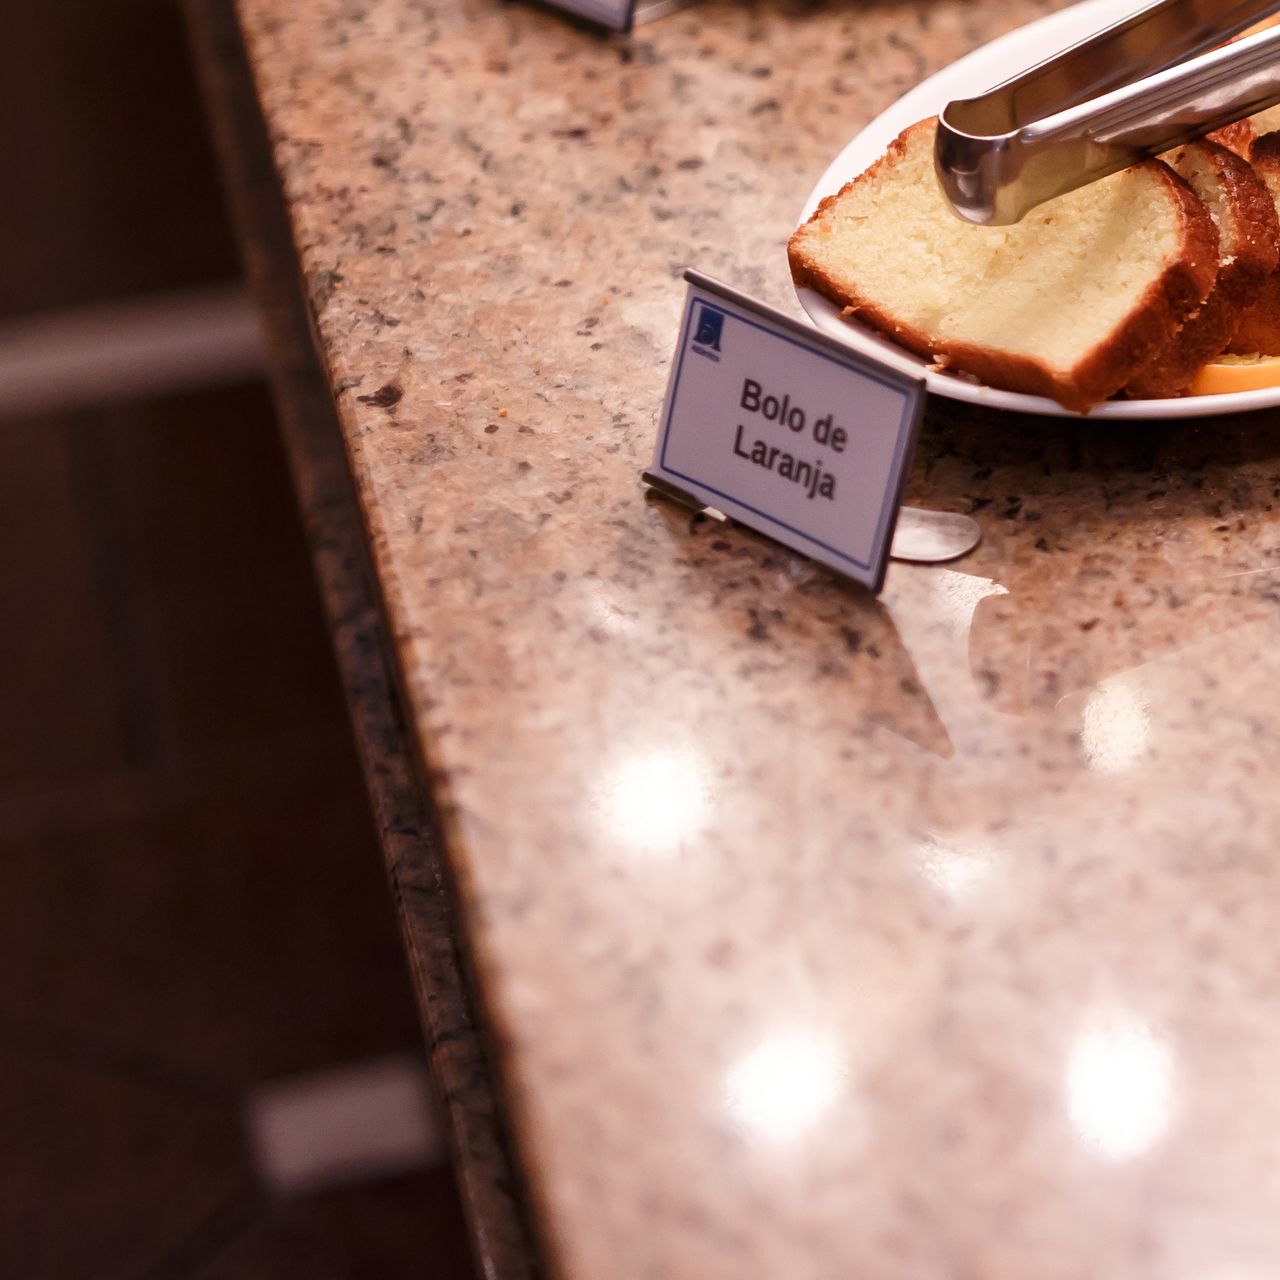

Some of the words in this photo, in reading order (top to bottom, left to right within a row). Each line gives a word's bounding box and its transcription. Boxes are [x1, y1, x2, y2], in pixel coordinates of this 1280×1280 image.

[739, 378, 806, 433] Bolo
[812, 414, 849, 453] de
[732, 425, 837, 501] Laranja
